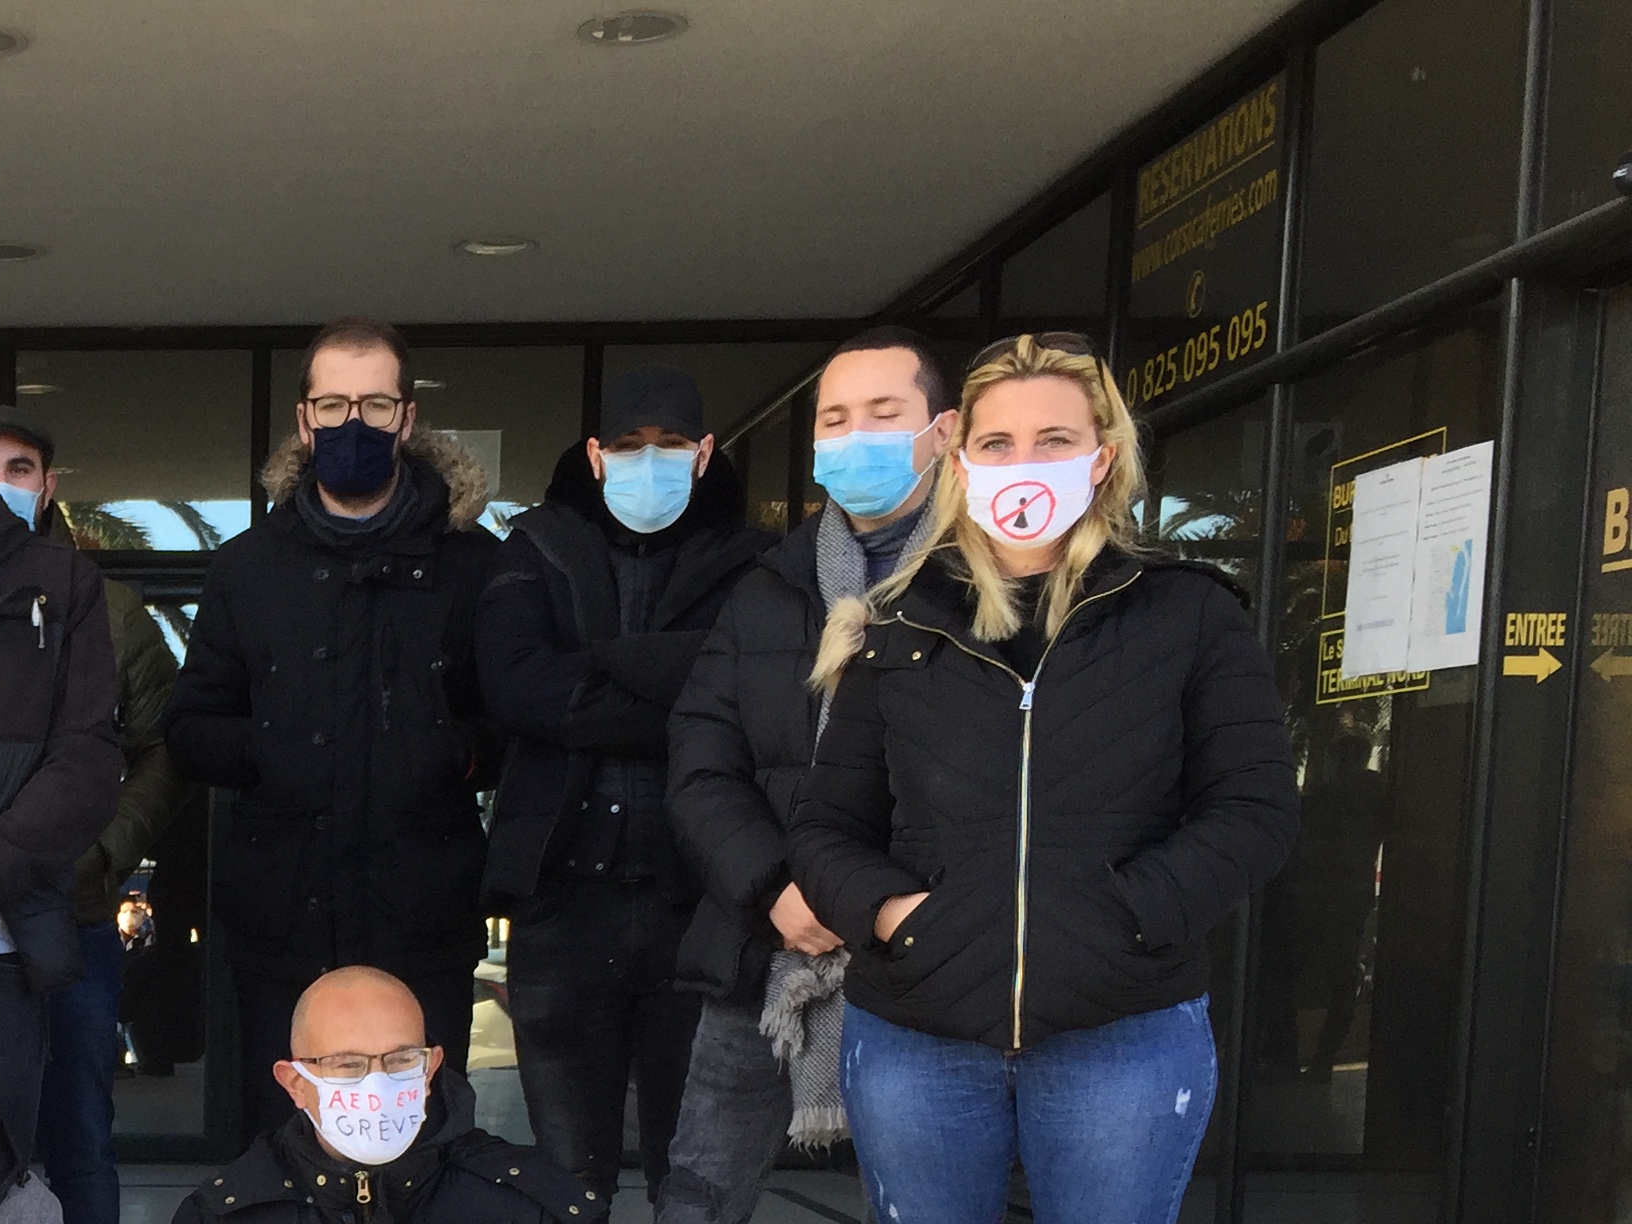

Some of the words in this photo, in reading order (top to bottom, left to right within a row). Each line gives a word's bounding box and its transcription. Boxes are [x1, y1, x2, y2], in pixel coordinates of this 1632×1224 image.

[1136, 81, 1277, 218] RESERVATIONS
[1126, 367, 1138, 409] 0
[1142, 346, 1178, 401] 825
[1183, 325, 1220, 382] 095
[1227, 301, 1268, 361] 095
[1504, 613, 1567, 646] ENTREE
[328, 1090, 382, 1112] AED
